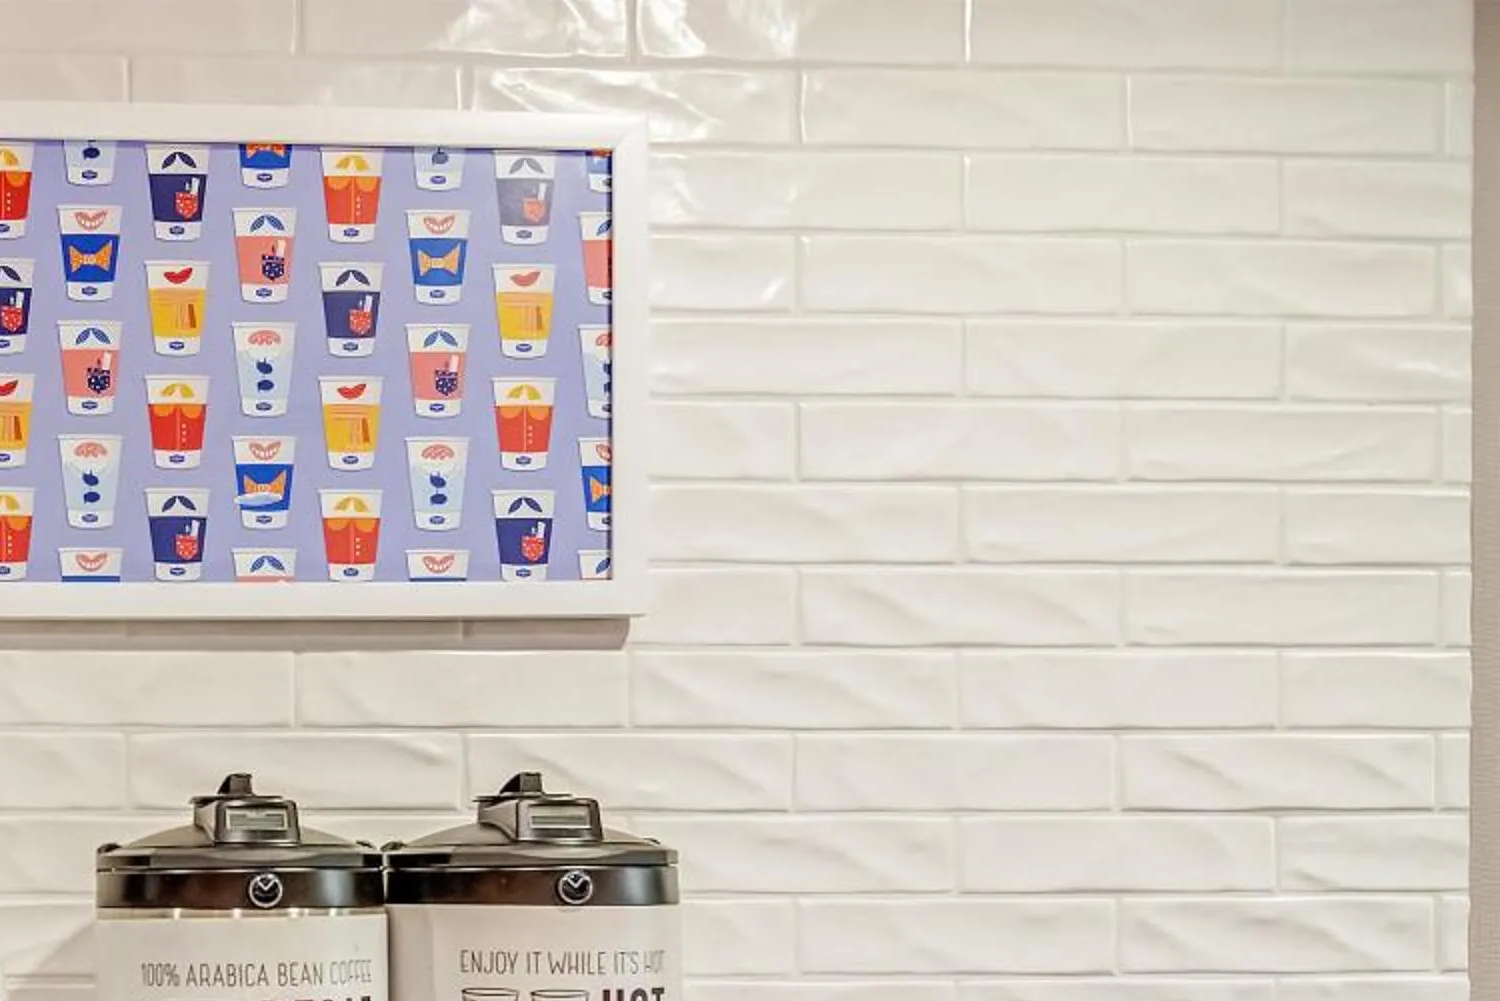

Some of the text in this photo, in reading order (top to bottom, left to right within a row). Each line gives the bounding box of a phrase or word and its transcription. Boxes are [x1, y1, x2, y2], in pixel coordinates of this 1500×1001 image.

[141, 959, 372, 987] 100% ARABICA BEAN COFFEE
[460, 949, 518, 975] ENJOY
[526, 951, 542, 974] IT
[548, 950, 606, 975] WHILE
